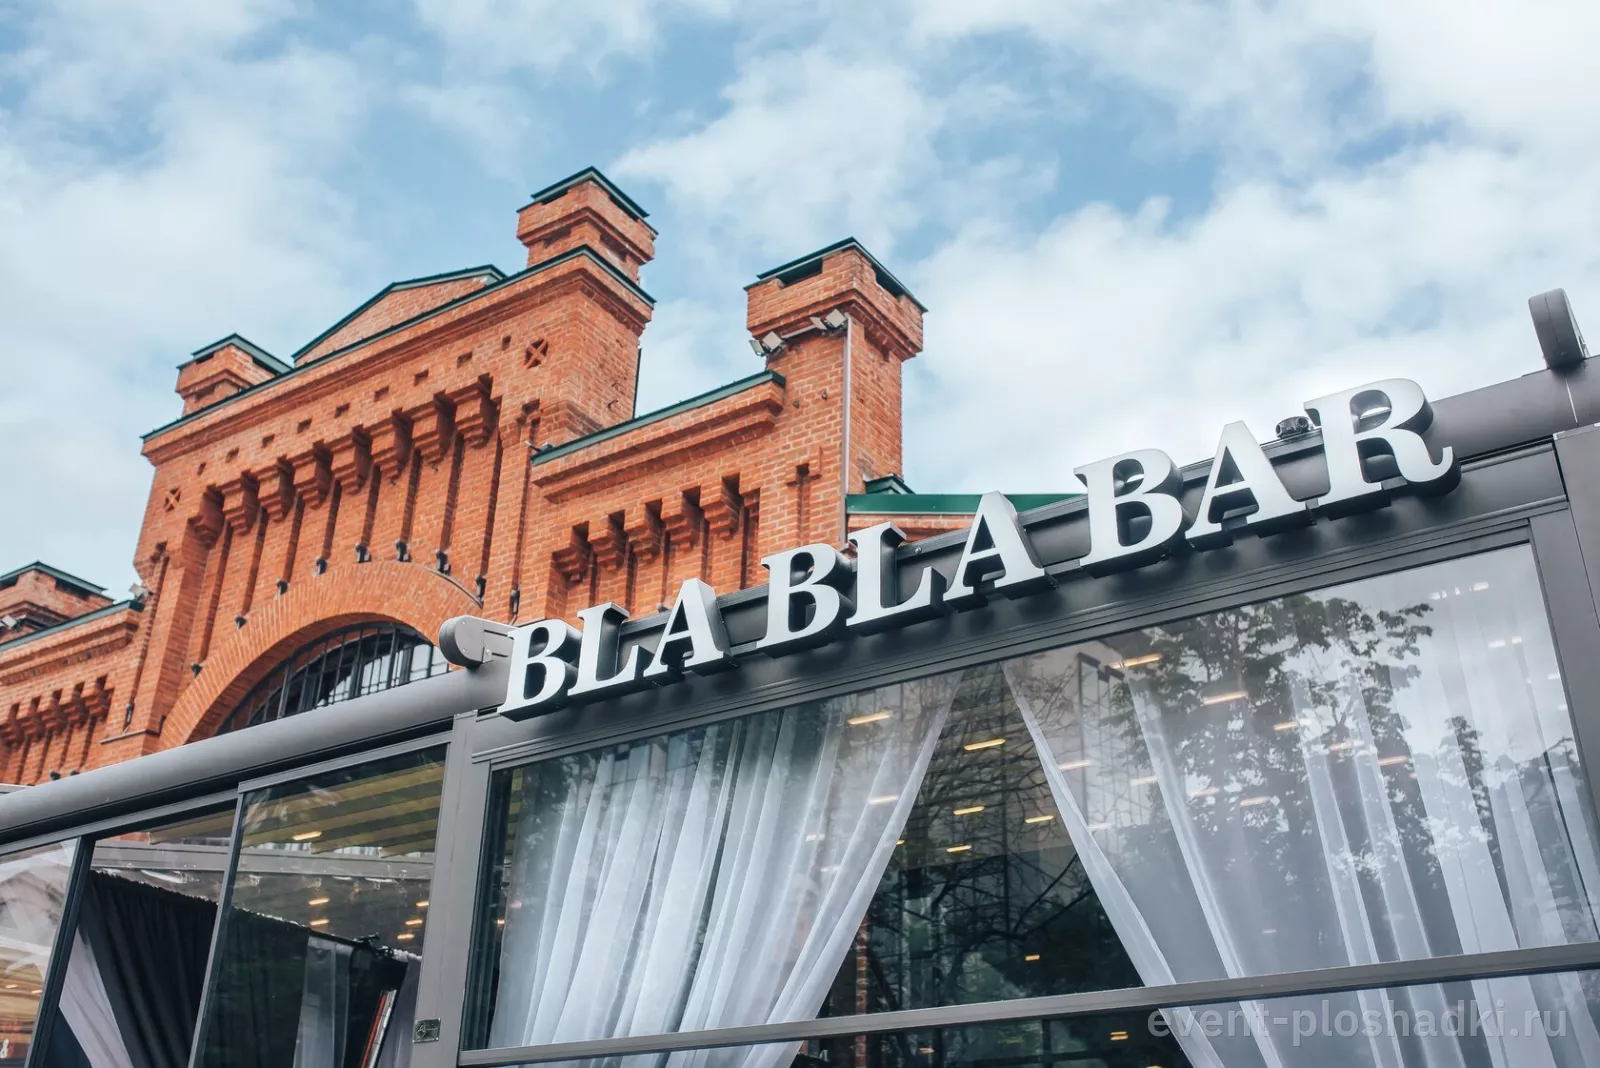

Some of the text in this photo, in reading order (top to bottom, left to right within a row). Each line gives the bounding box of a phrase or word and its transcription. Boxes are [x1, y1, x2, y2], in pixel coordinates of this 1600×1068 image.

[497, 377, 1456, 716] BLA BLA BAR
